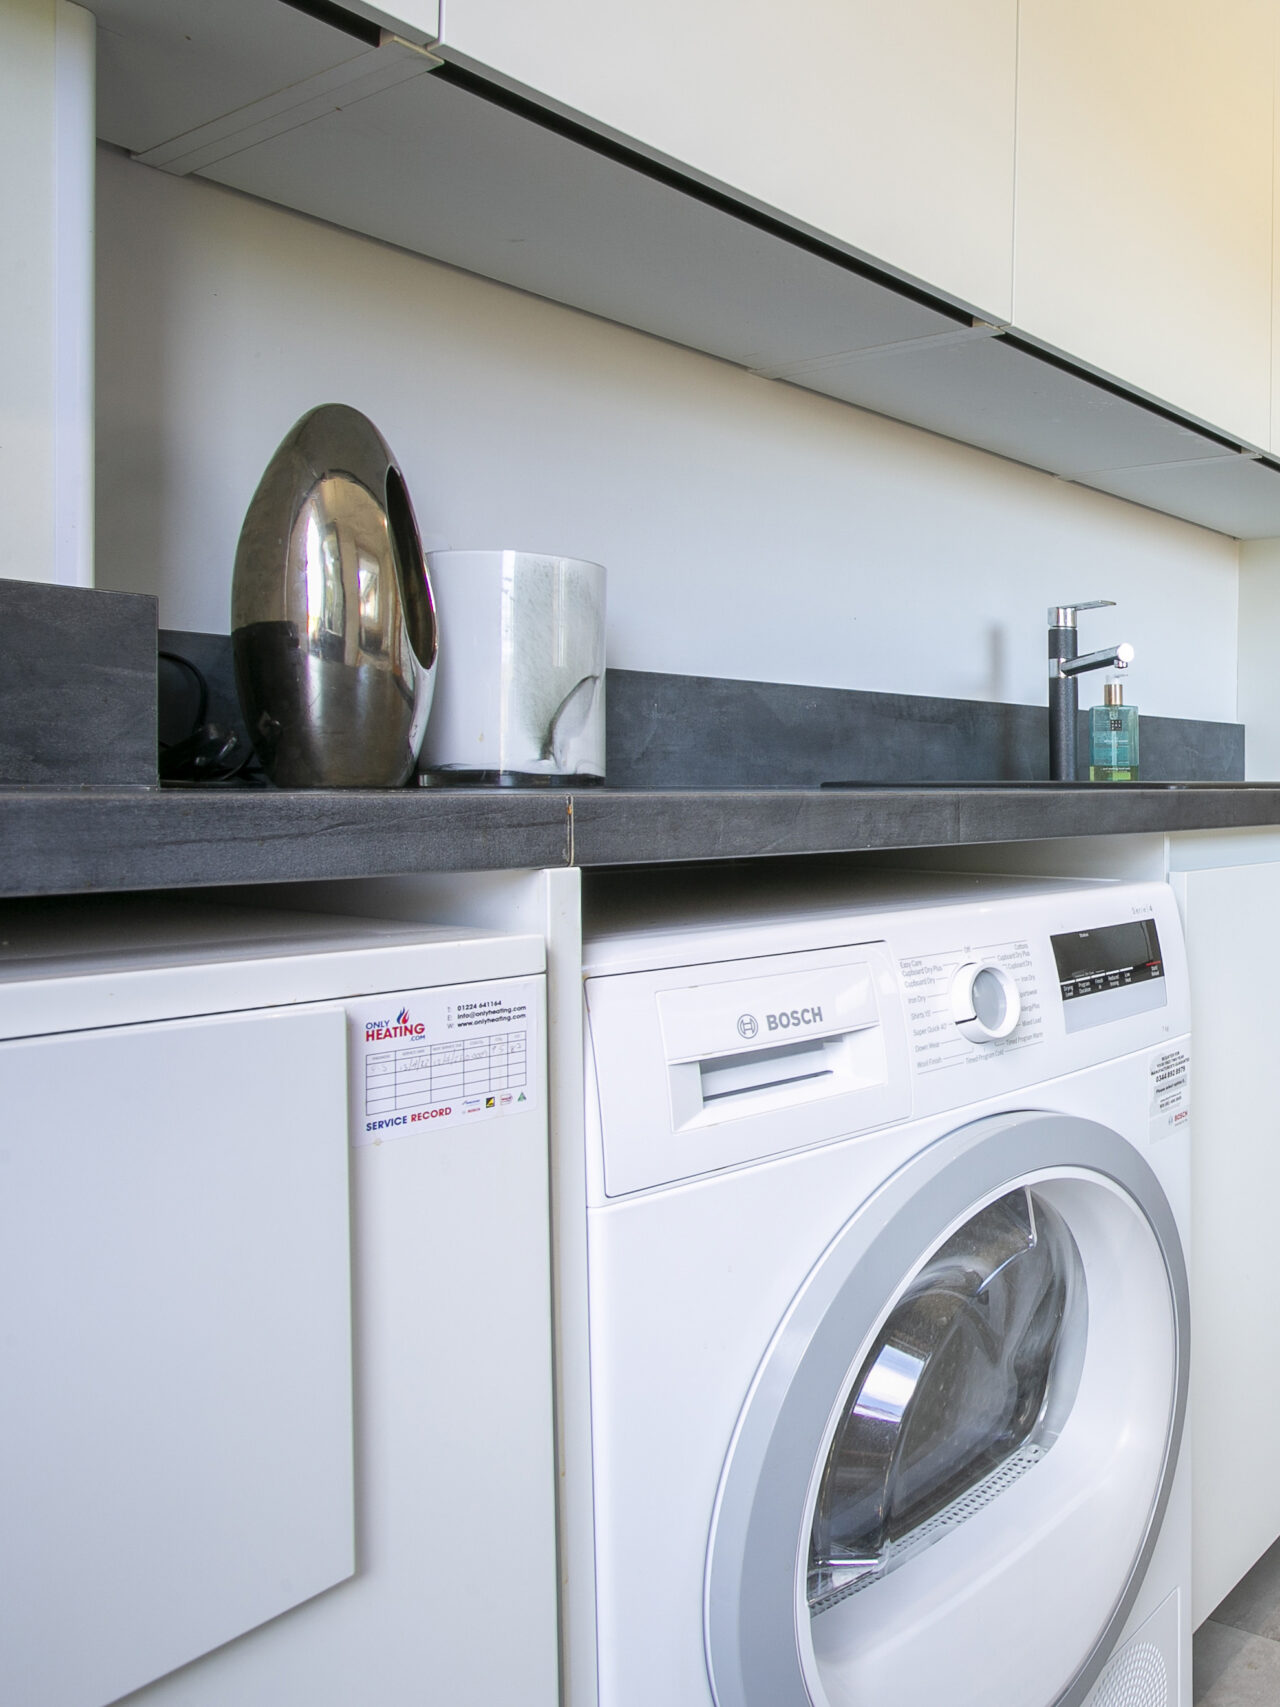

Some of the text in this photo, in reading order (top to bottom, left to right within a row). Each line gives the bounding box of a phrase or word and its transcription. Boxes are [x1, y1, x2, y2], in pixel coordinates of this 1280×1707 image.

[900, 961, 910, 969] Easy
[902, 968, 924, 976] Cupboard
[924, 967, 932, 975] Dry
[904, 979, 927, 988] Cupboard
[918, 996, 926, 1004] Dry
[457, 1004, 478, 1012] 01224
[478, 1000, 502, 1009] 641164
[457, 1005, 526, 1020] info@onlyheating.com
[911, 1012, 924, 1020] Shirts
[457, 1013, 526, 1028] www.onlyheating.com
[766, 1006, 823, 1031] BOSCH
[366, 1020, 390, 1030] ONLY
[366, 1024, 426, 1042] HEATING
[913, 1028, 926, 1036] Super
[927, 1025, 940, 1033] Quick
[915, 1045, 928, 1053] Down
[978, 1052, 994, 1062] Program
[1156, 1073, 1166, 1082] 0344
[1176, 1065, 1186, 1075] 8979
[366, 1107, 452, 1132] SERVICE RECORD
